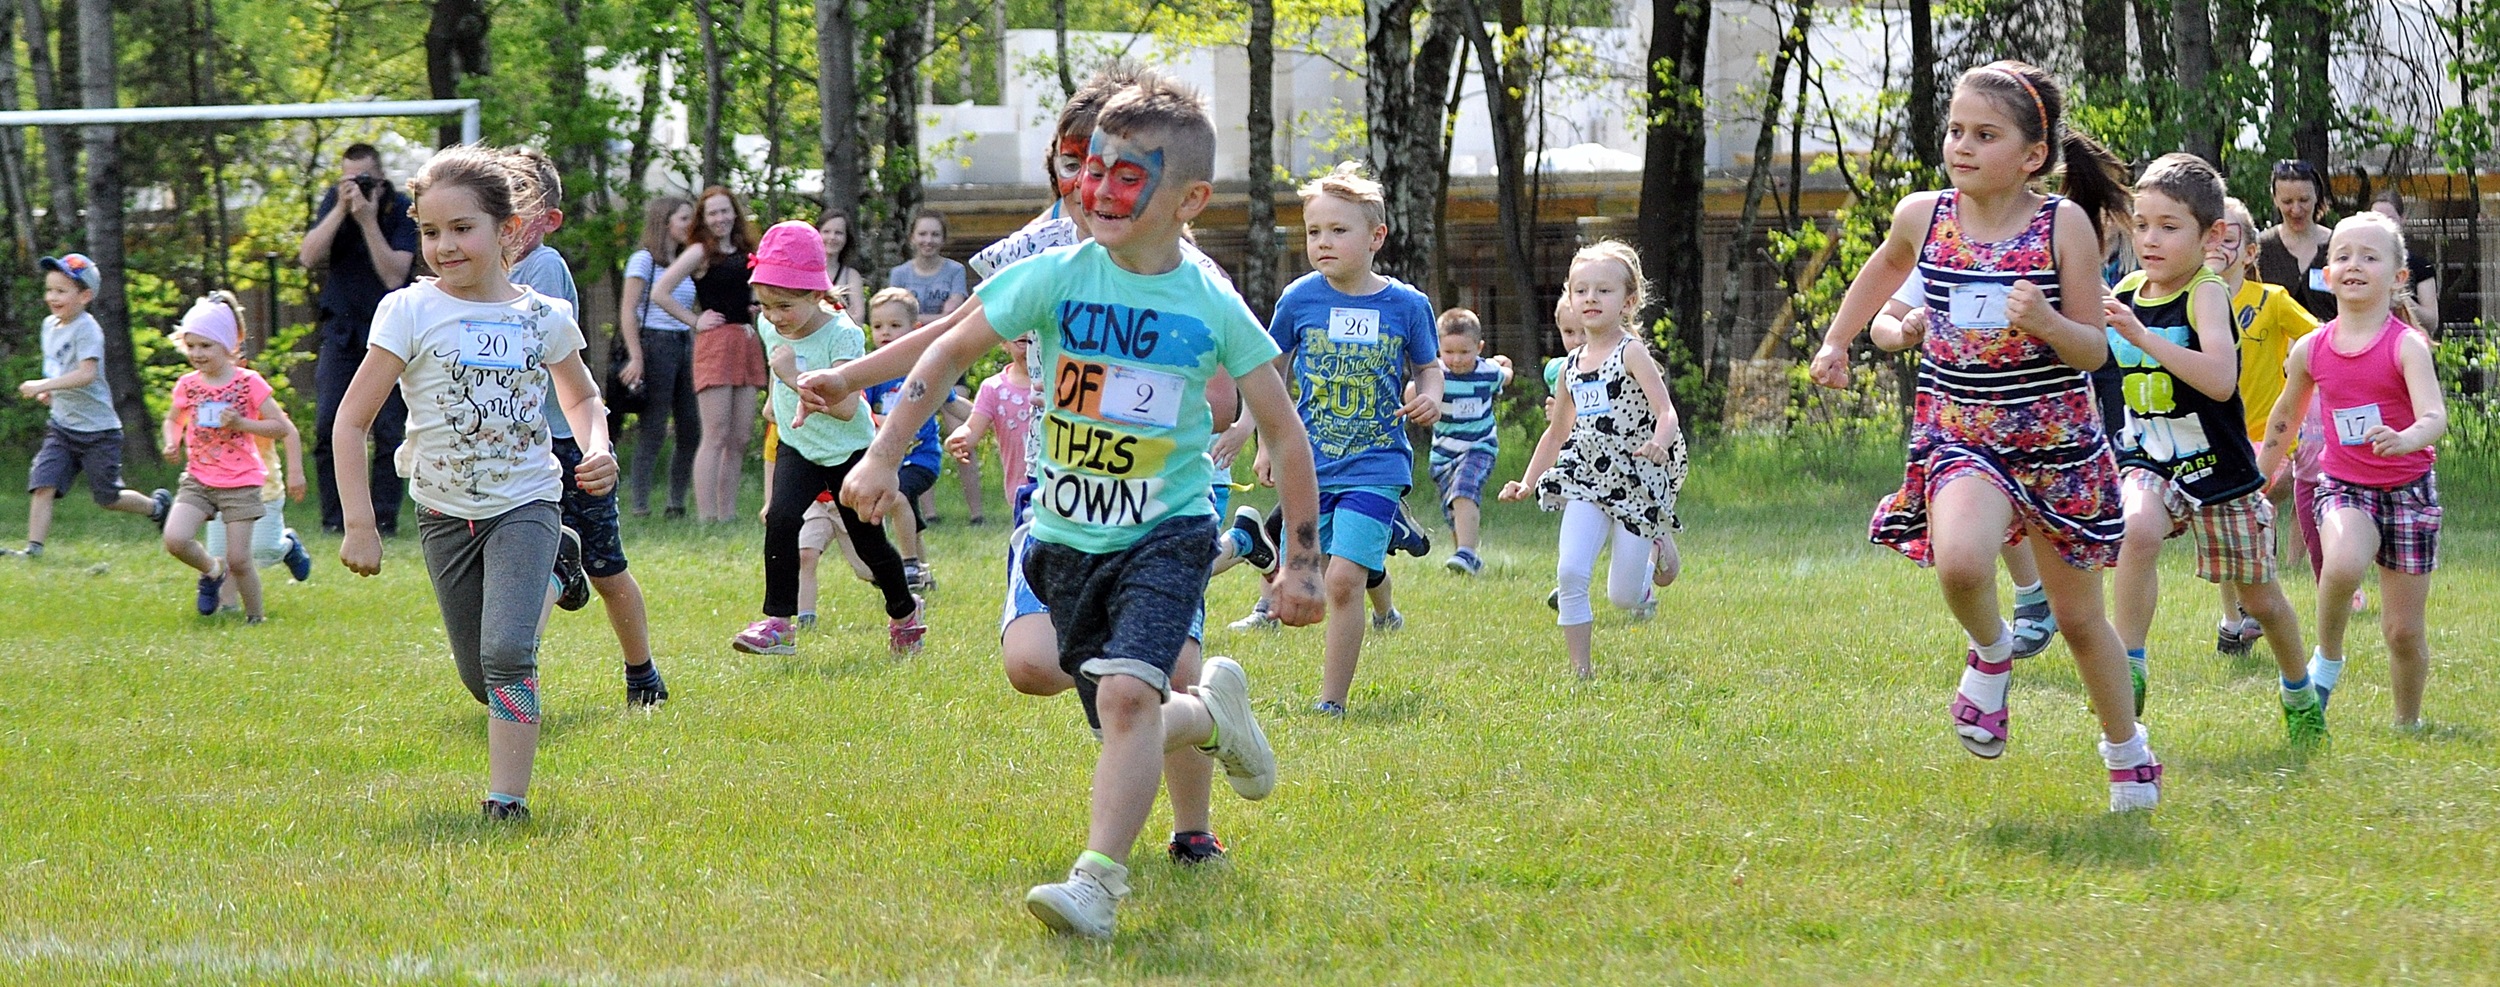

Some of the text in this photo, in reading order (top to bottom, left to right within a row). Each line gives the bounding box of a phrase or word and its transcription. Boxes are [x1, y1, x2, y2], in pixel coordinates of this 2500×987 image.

[1974, 294, 1988, 319] 7
[1061, 300, 1160, 359] KING
[1344, 317, 1369, 337] 26
[477, 332, 508, 358] 20
[472, 368, 513, 389] me
[1057, 361, 1104, 413] OF
[447, 386, 535, 436] Smile
[1132, 383, 1154, 413] 2
[1581, 389, 1600, 409] 22
[2345, 416, 2366, 437] 17
[1049, 415, 1138, 474] THIS
